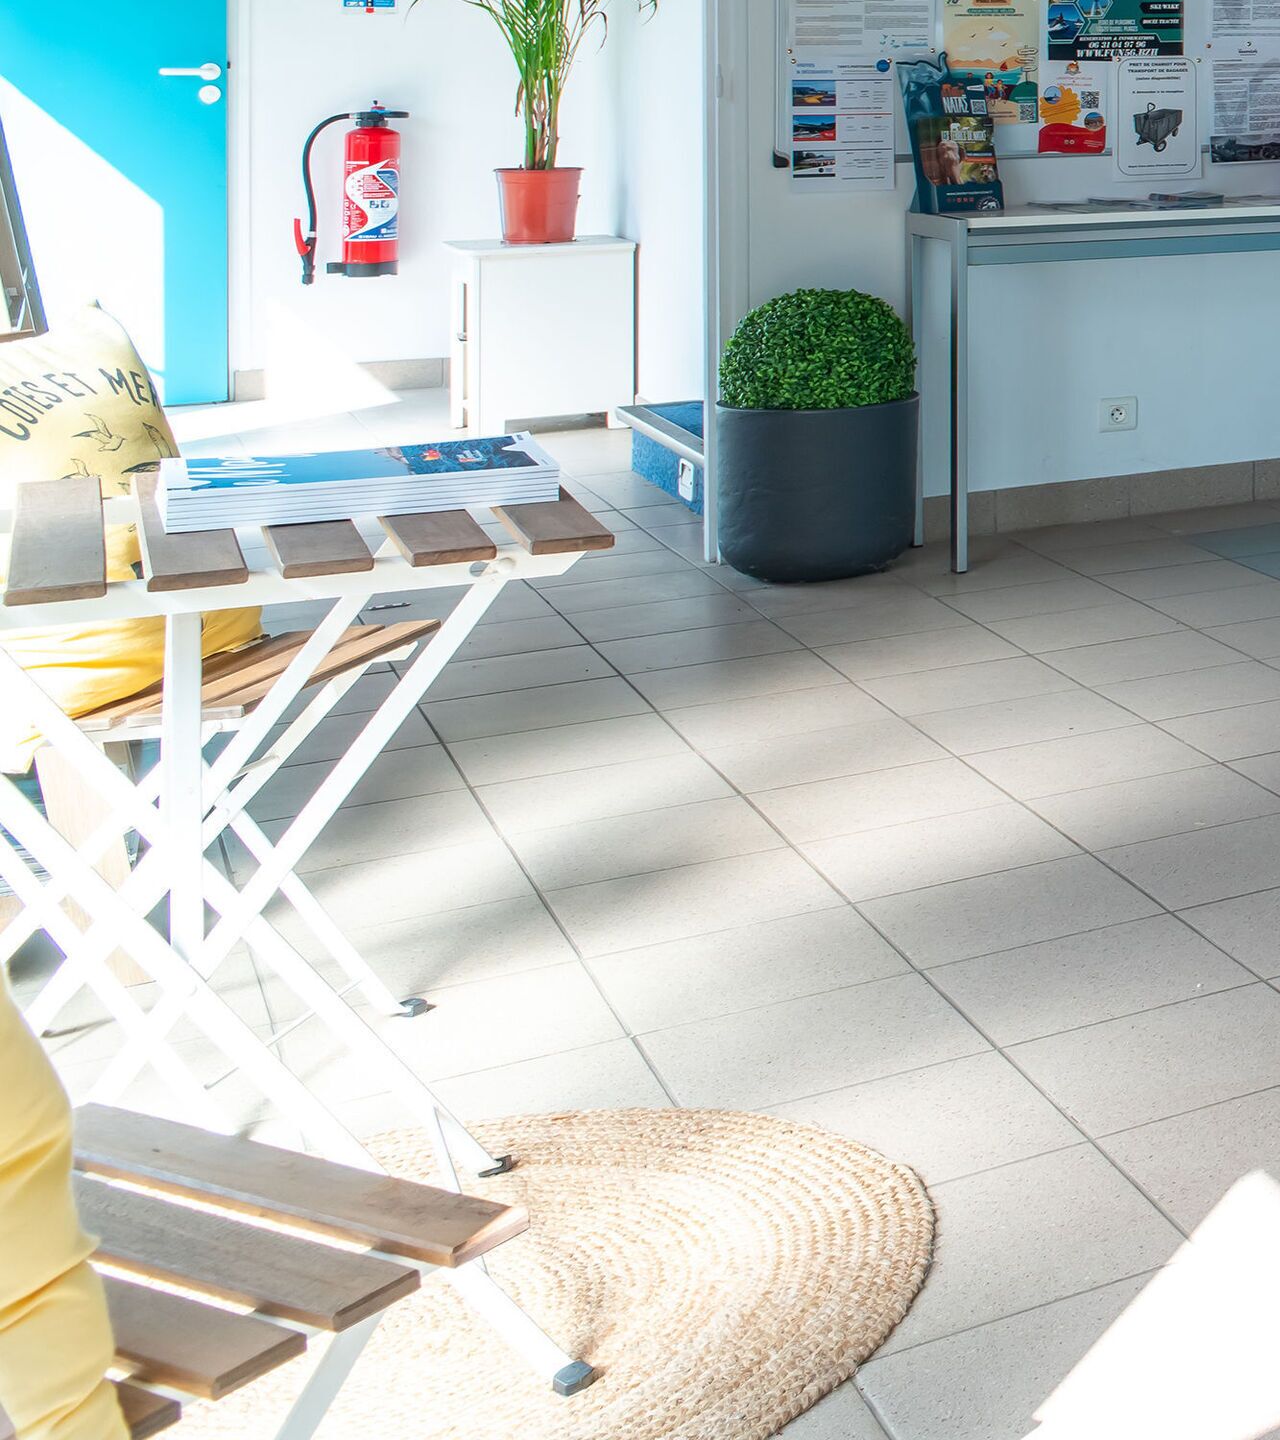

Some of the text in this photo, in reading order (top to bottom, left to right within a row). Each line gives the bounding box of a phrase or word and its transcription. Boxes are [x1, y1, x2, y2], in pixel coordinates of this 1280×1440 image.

[1088, 41, 1100, 49] 06
[1076, 48, 1160, 58] WWW.FUN56.BZH
[43, 372, 98, 398] ET
